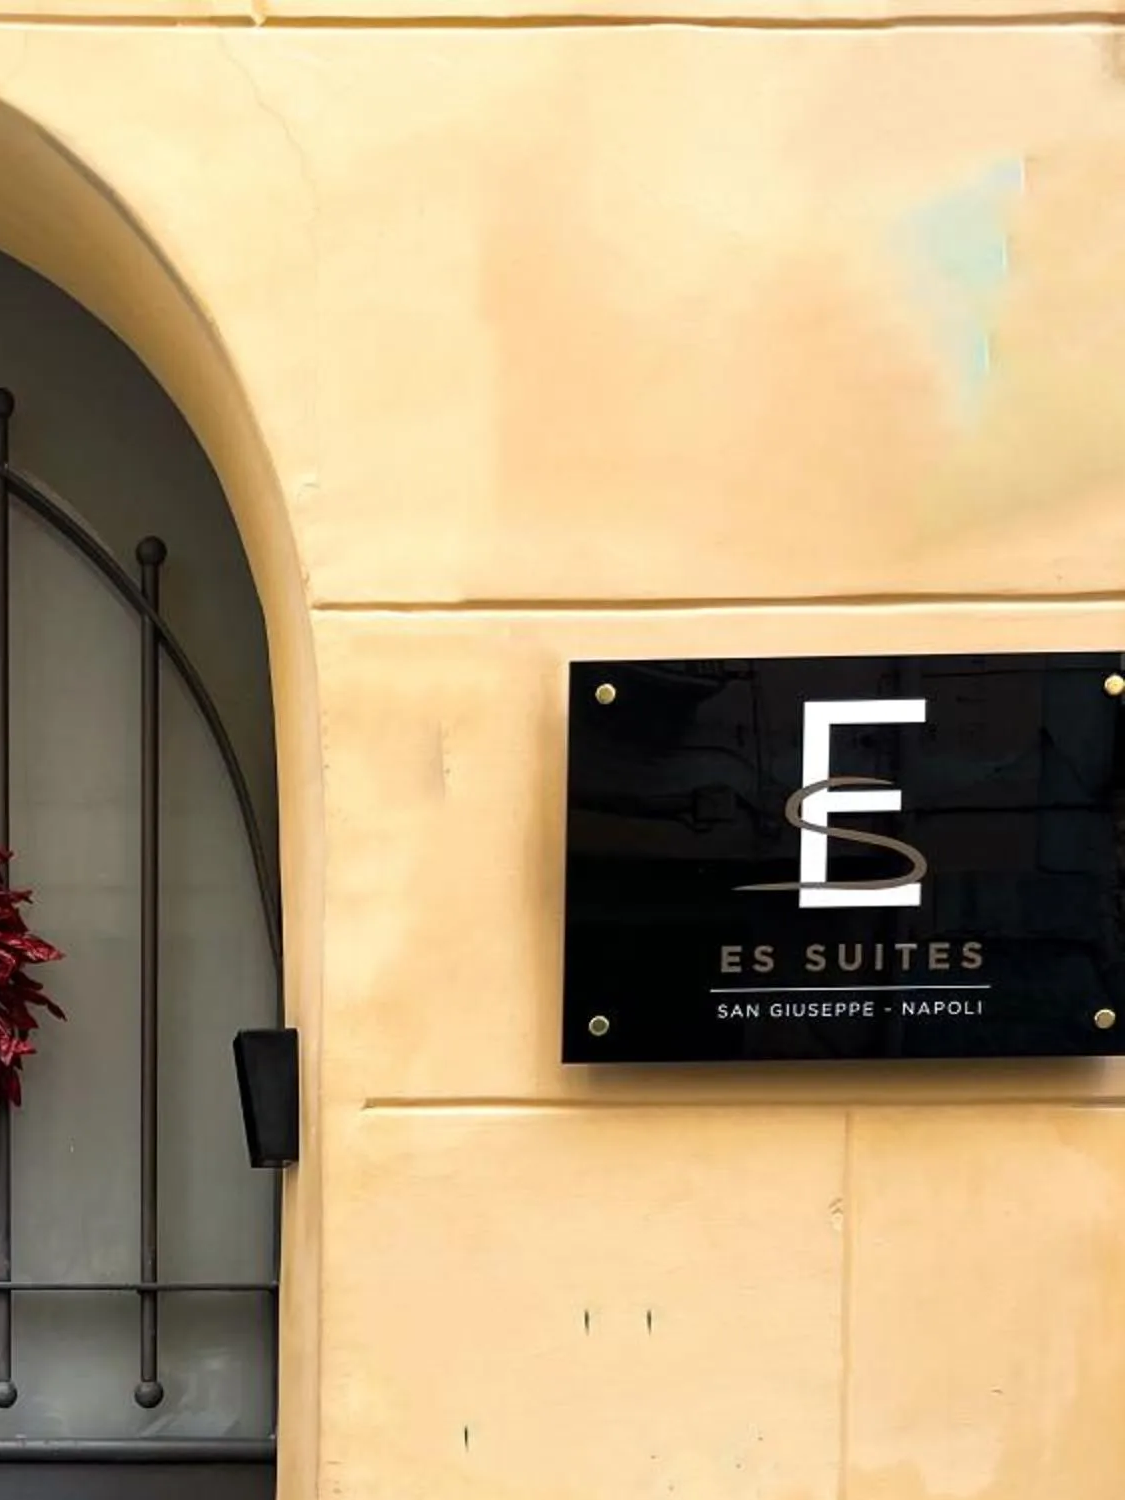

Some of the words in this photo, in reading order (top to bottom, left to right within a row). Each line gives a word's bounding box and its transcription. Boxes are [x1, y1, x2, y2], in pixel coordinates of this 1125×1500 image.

[720, 944, 775, 974] ES
[805, 941, 983, 972] SUITES
[717, 1002, 760, 1019] SAN
[769, 1000, 875, 1018] GIUSEPPE
[901, 1000, 983, 1016] NAPOLI
